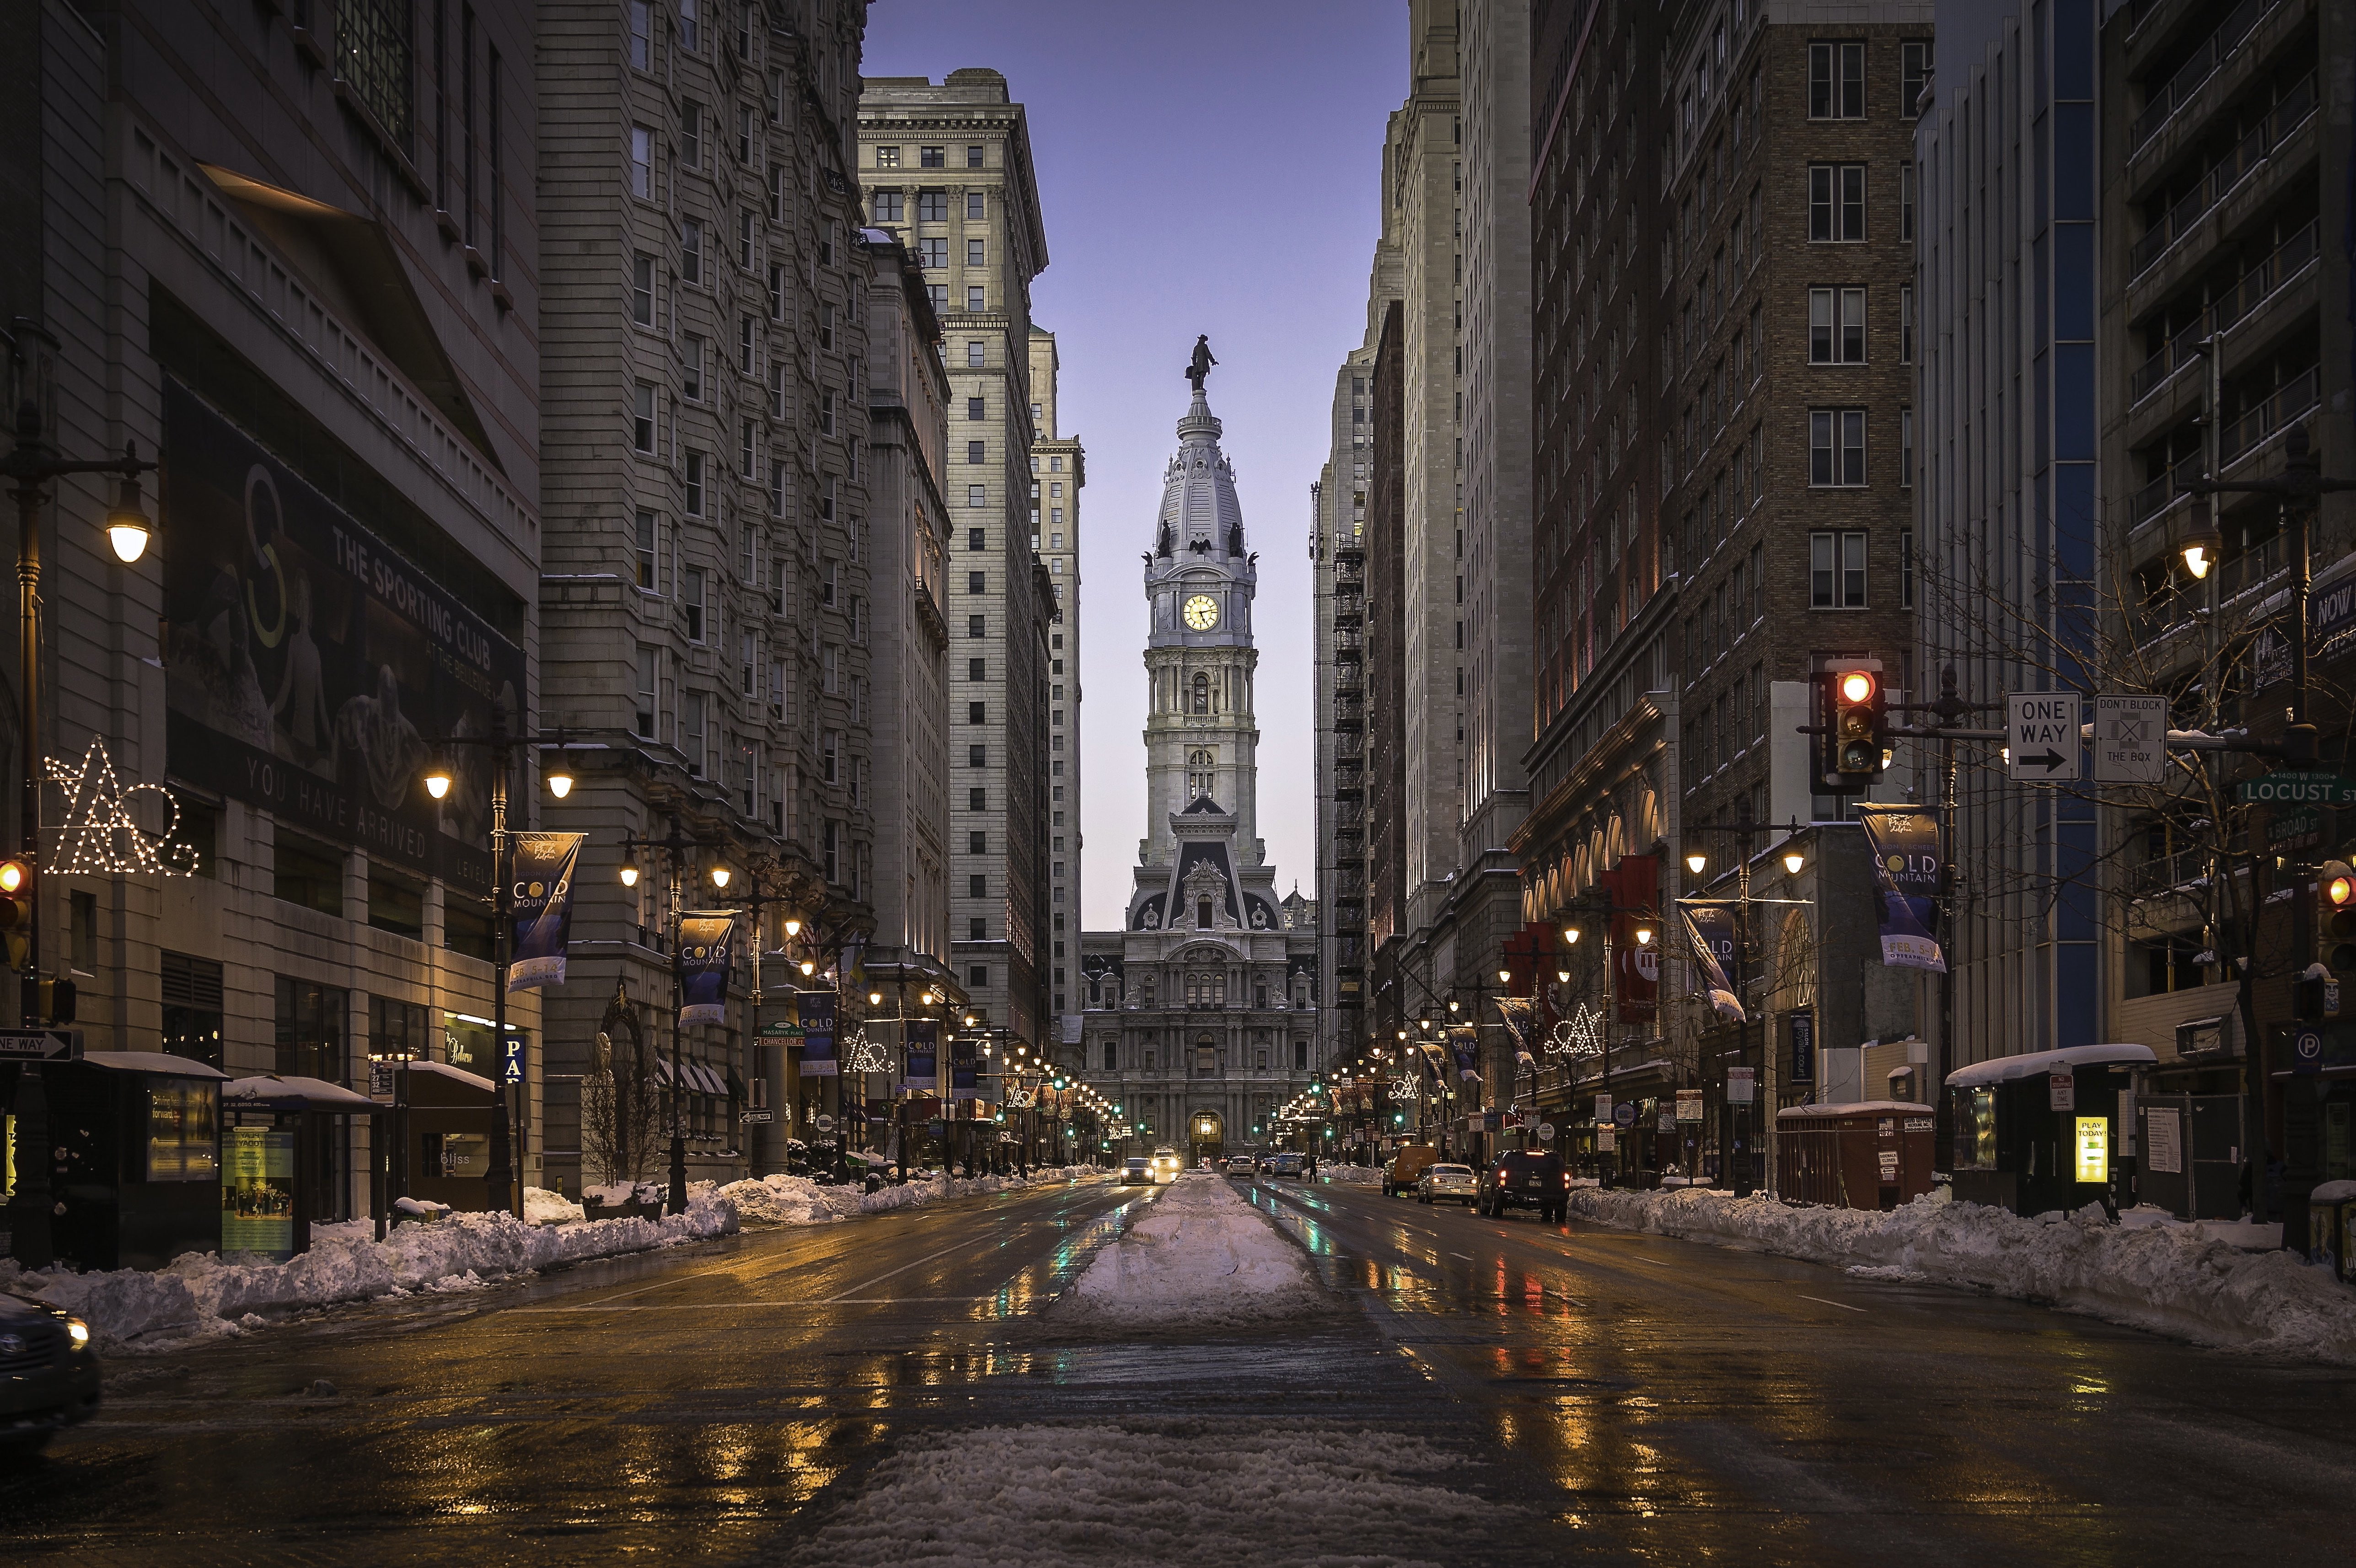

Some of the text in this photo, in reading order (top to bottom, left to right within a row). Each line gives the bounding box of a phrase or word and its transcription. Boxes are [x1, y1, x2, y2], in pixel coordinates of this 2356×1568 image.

[333, 525, 490, 671] THE SPORTING CLUB
[2318, 585, 2351, 627] NOW
[2022, 701, 2065, 720] ONE
[2100, 699, 2161, 709] DON'T BLOCK
[2020, 724, 2067, 743] WAY
[2107, 752, 2150, 762] THE BOX
[2299, 772, 2308, 781] W
[2247, 783, 2356, 801] LOCUST ST
[247, 756, 425, 859] YOU HAVE ARRIVED
[2275, 816, 2318, 839] BROAD ST
[457, 858, 486, 884] LEVEL
[1878, 870, 1935, 884] MUNTAIN
[513, 879, 569, 899] COLD
[682, 945, 726, 959] COLD
[1889, 942, 1915, 953] FEB.
[1890, 954, 1943, 964] OPERAPHILA.ORG
[801, 1018, 833, 1028] COLD
[0, 1038, 44, 1050] NE WAY
[908, 1042, 934, 1050] COLD
[2305, 1038, 2315, 1054] P
[1796, 1028, 1806, 1077] royale court
[440, 1153, 470, 1164] bliss
